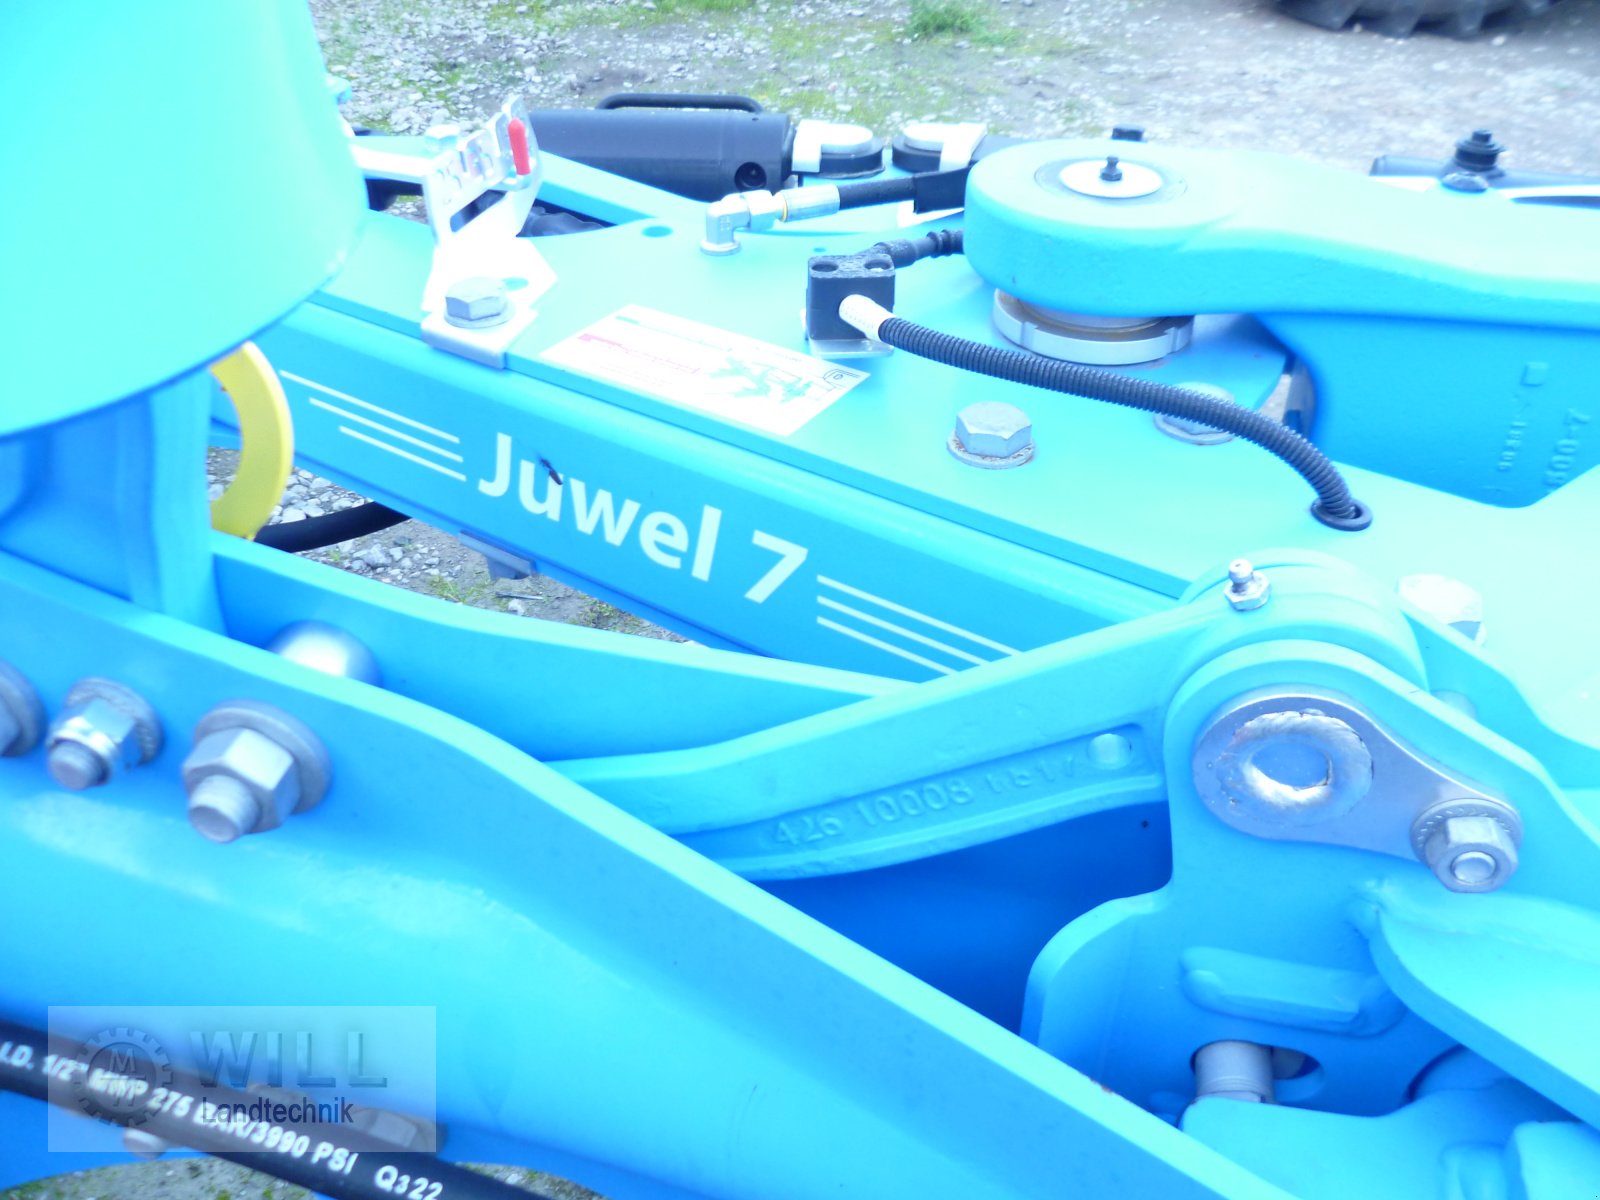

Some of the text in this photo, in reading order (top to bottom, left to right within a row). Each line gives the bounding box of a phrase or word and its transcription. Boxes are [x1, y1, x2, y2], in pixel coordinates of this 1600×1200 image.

[478, 432, 809, 604] Juwel 7
[855, 776, 975, 827] 10008
[147, 1087, 194, 1117] 275
[311, 1141, 359, 1175] PSI
